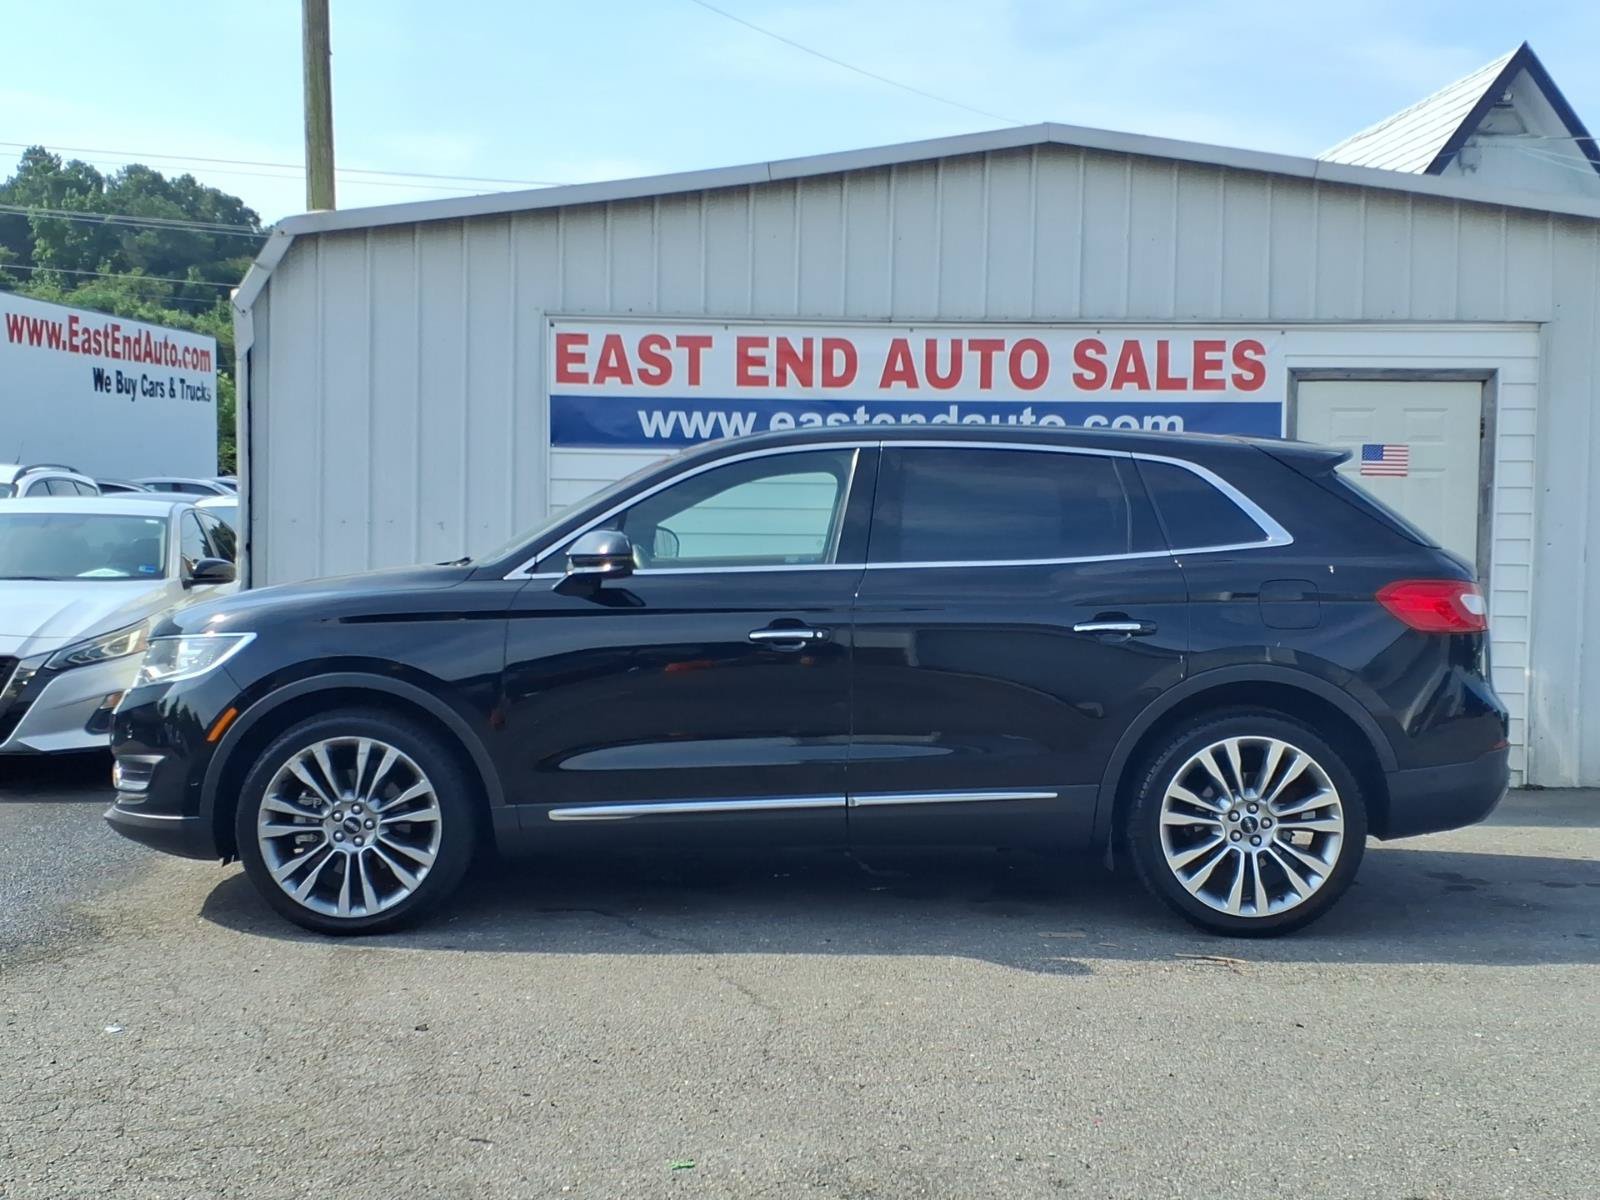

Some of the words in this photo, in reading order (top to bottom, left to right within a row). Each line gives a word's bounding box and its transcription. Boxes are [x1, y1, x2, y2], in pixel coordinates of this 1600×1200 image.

[5, 312, 212, 373] www.EastEndAuto.com
[555, 333, 713, 386] EAST
[736, 336, 859, 388] END
[879, 338, 1050, 390] AUTO
[1072, 338, 1267, 391] SALES
[92, 367, 112, 394] We
[115, 370, 137, 402] Buy
[140, 373, 165, 398] Cars
[168, 377, 176, 399] &
[179, 378, 211, 402] Trucks
